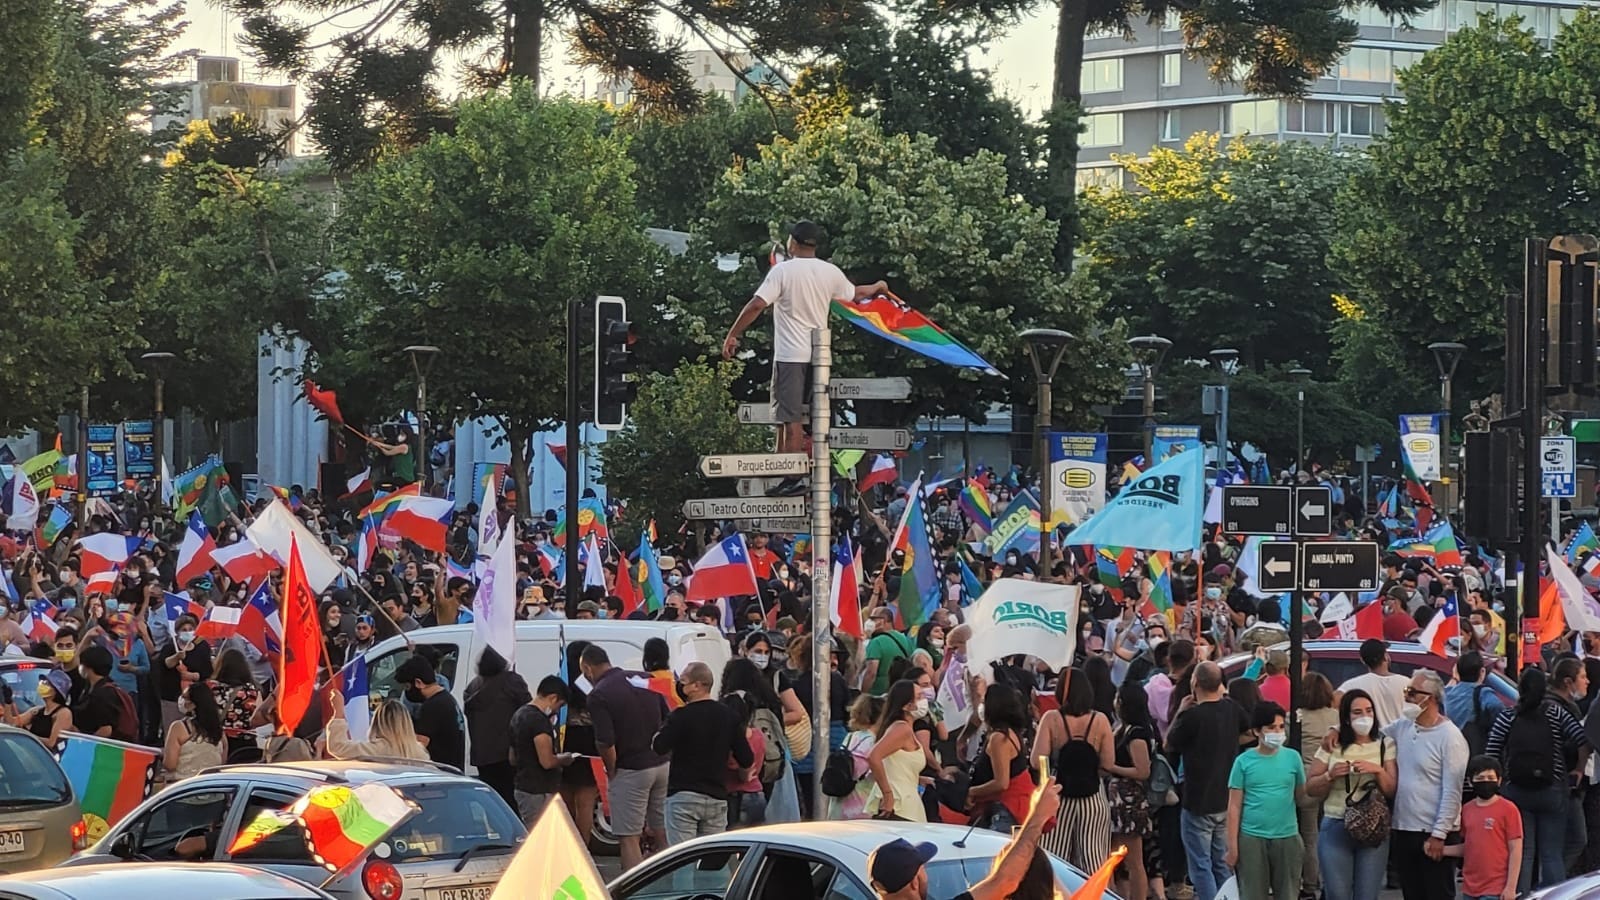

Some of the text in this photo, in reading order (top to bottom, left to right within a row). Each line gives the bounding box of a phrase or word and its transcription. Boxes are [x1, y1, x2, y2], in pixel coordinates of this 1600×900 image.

[839, 383, 860, 395] Correo
[840, 432, 869, 445] Tribunales
[737, 459, 796, 472] Parque Ecuador
[1230, 496, 1259, 506] O'HIGGINS
[711, 501, 790, 516] Teatro Concepción
[1311, 554, 1354, 564] ANIBAL PINTO
[1308, 579, 1320, 588] 401
[1359, 579, 1371, 588] 499
